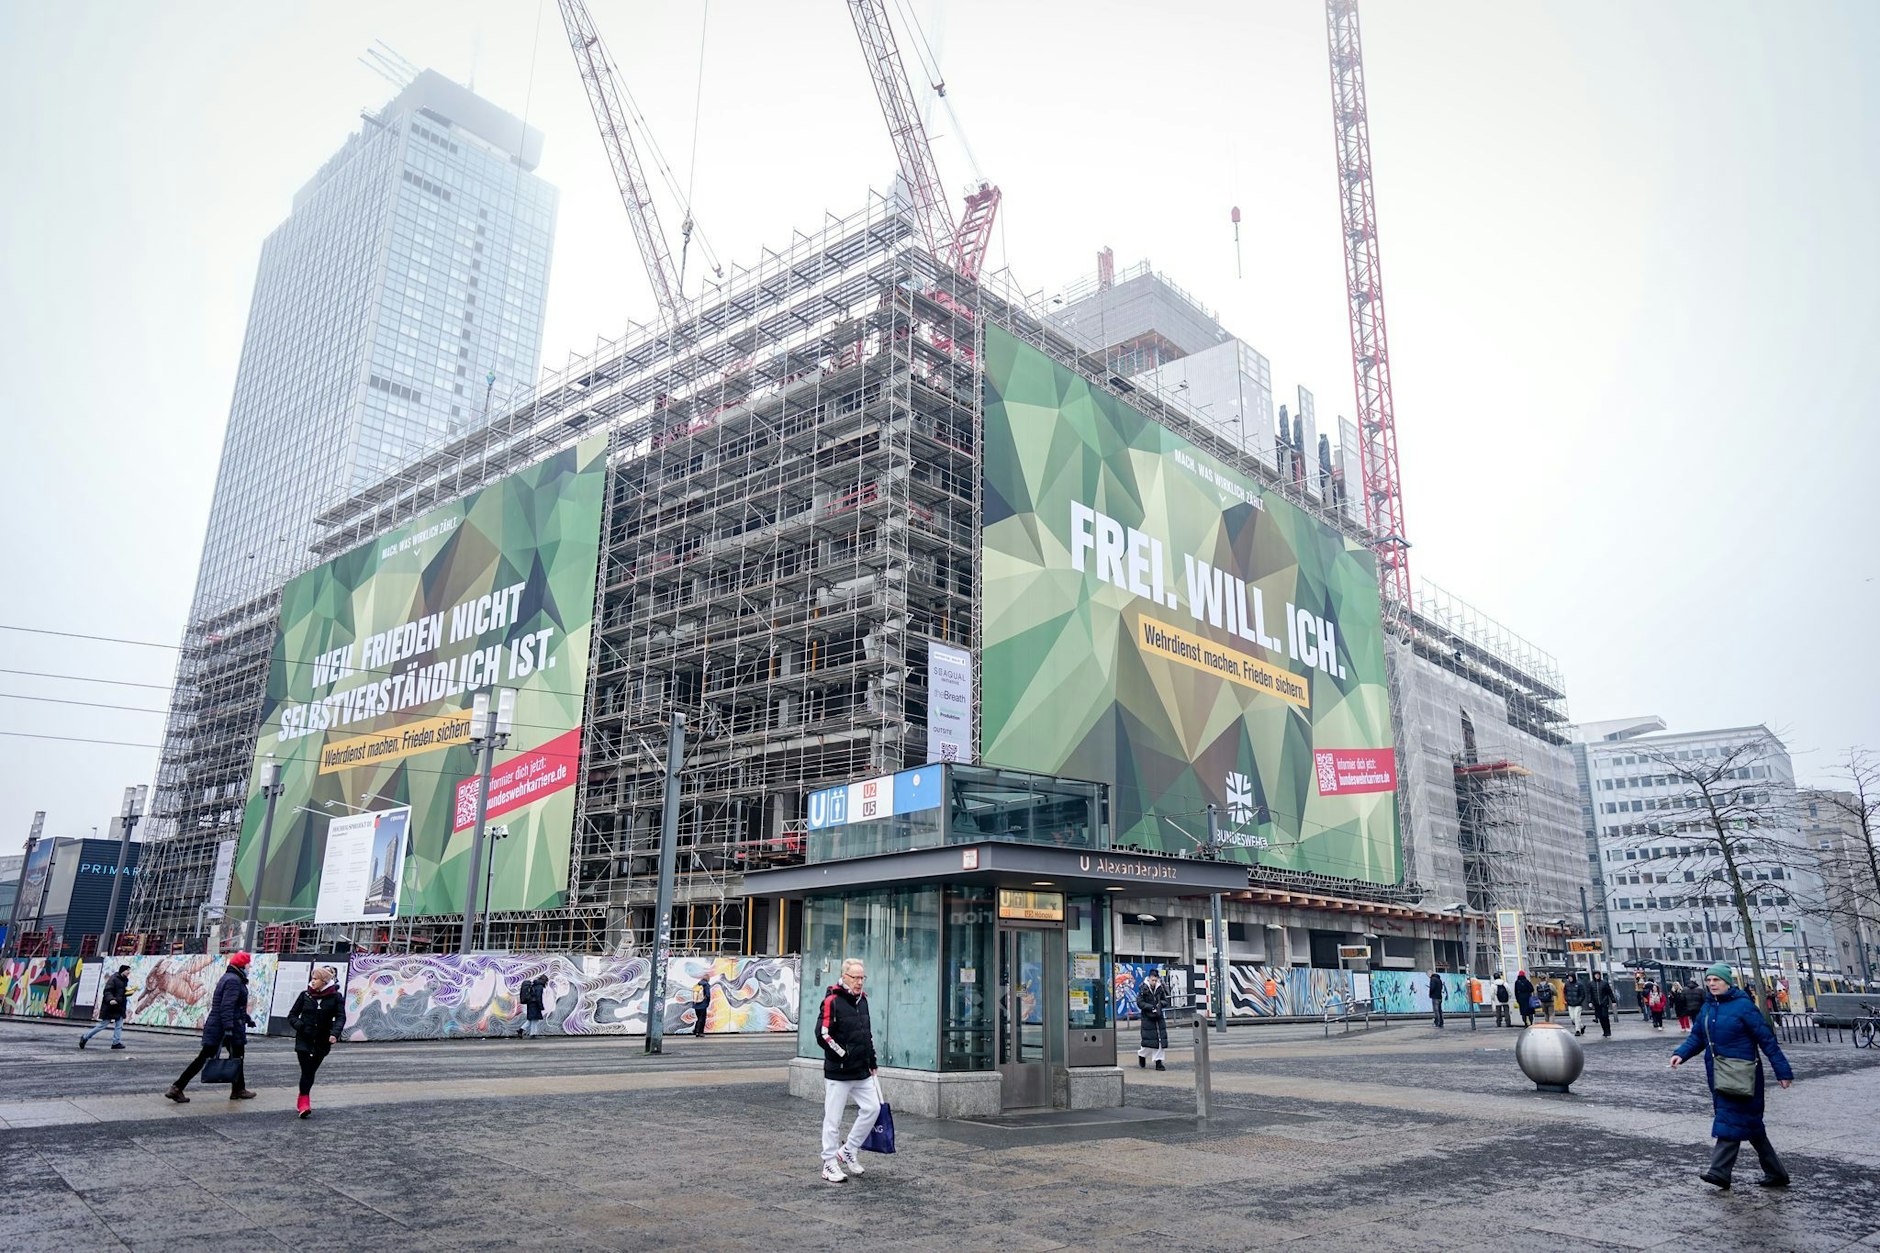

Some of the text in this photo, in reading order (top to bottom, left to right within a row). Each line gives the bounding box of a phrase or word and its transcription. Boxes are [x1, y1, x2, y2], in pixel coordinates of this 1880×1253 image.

[1174, 449, 1265, 512] MACH, WAS WIRKLICH ZÄHLT.
[399, 537, 412, 552] WAS
[412, 525, 439, 546] WIRKLICH
[1070, 500, 1346, 680] FREI. WILL. ICH.
[311, 581, 526, 688] WEIL FRIEDEN NICHT
[1144, 622, 1306, 701] Wehrdienst machen, Frieden sichern.
[277, 627, 556, 743] SELBSTVERSTÄNDLICH IST.
[934, 689, 966, 704] theBreath
[324, 743, 366, 768] Wehrdienst
[367, 736, 400, 757] machen,
[401, 727, 434, 750] Frieden
[487, 764, 567, 810] undeswehrkarriere.de
[488, 756, 547, 792] nformier dich jetzt:
[864, 783, 876, 797] U2
[811, 792, 826, 827] U
[864, 802, 876, 816] U5
[1080, 855, 1177, 880] U Alexanderplatz
[1000, 891, 1010, 907] U
